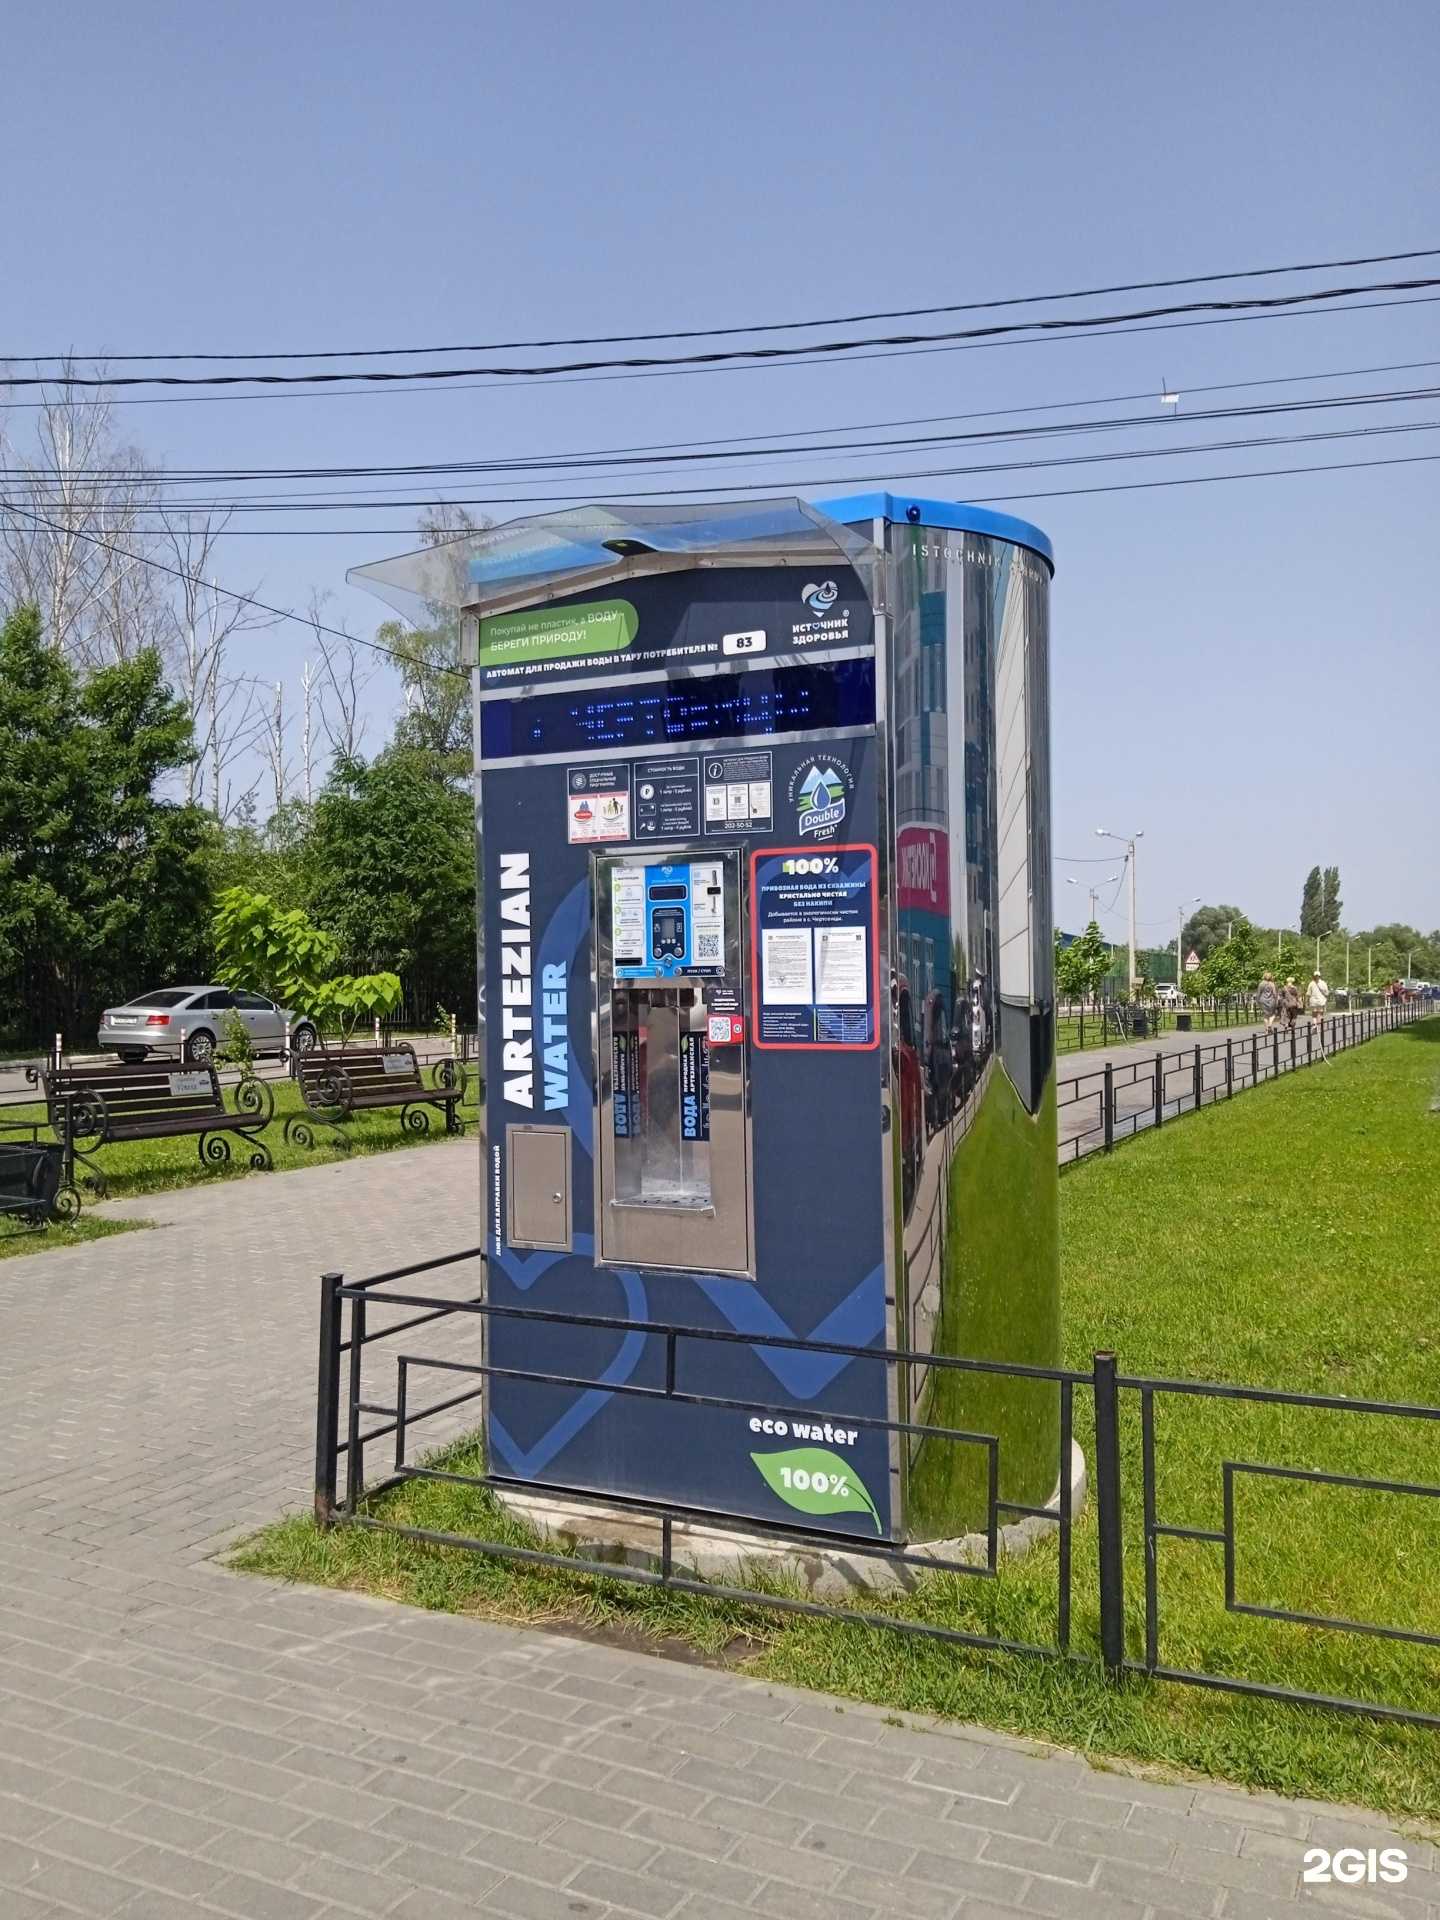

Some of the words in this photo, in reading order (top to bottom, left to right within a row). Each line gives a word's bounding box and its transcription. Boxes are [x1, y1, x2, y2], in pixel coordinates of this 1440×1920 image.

[490, 623, 527, 637] Покупай
[528, 623, 539, 631] не
[792, 618, 849, 633] ИСТОЧНИК
[490, 636, 530, 651] БЕРЕГИ
[532, 629, 587, 646] ПРИРОДУ!
[736, 636, 753, 649] 83
[792, 630, 849, 645] ЗДОРОВЬЯ
[486, 667, 524, 679] АВТОМАТ
[525, 664, 542, 674] ДЛЯ
[543, 660, 586, 672] ПРОДАЖИ
[587, 656, 613, 667] ВОДЫ
[613, 655, 620, 663] В
[620, 652, 642, 662] ТАРУ
[643, 644, 707, 660] ПОТРЕБИТЕЛЯ
[818, 754, 855, 790] ТЕХНОЛОГИЯ
[804, 809, 840, 826] Double
[813, 825, 835, 838] Fresh
[785, 857, 840, 876] 100%
[761, 883, 799, 892] ПРИВОЗНАЯ
[827, 881, 866, 889] СКВАЖИНЫ
[779, 891, 821, 900] КРИСТАЛЬНО
[822, 890, 848, 898] ЧИСТАЯ
[499, 852, 534, 1110] ARTEZIAN
[542, 959, 569, 1111] WATER
[683, 1094, 697, 1137] ВОДА
[493, 1145, 501, 1175] ВОДОЙ
[749, 1417, 788, 1436] eco
[792, 1423, 859, 1446] water
[780, 1466, 849, 1497] 100%
